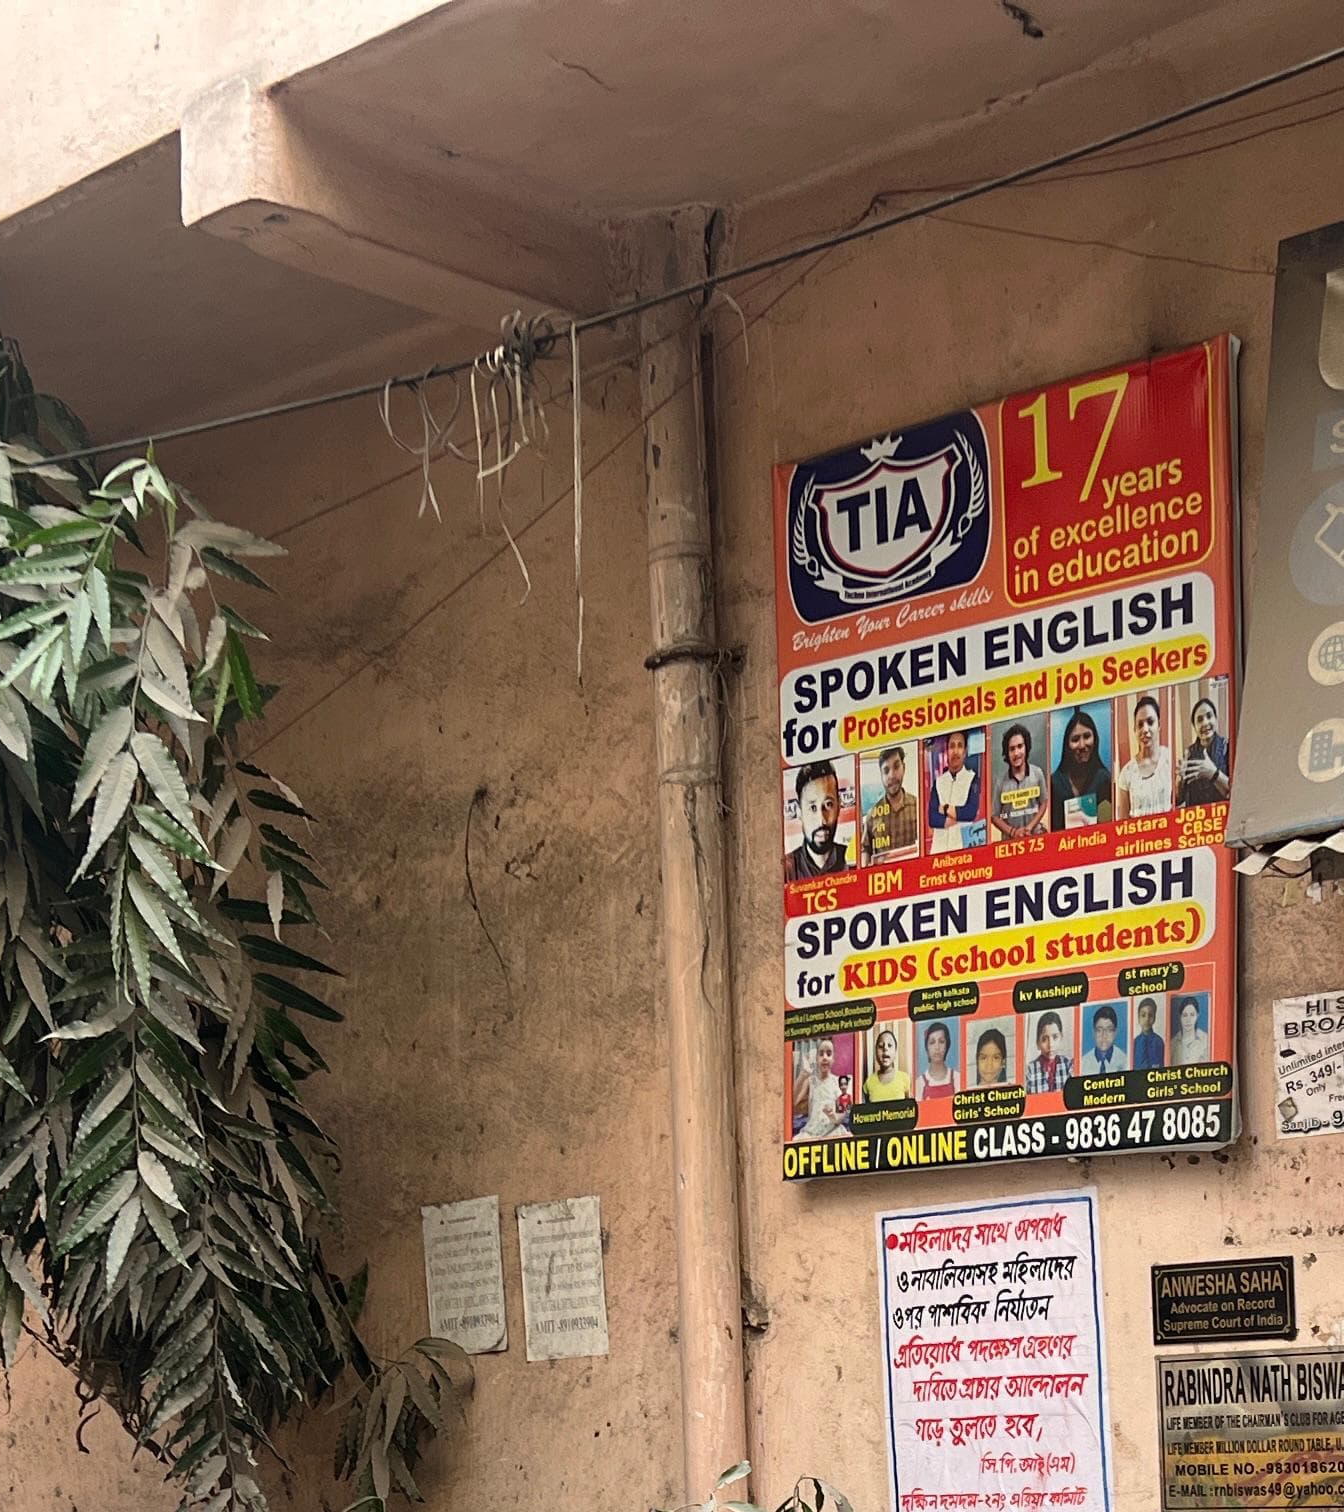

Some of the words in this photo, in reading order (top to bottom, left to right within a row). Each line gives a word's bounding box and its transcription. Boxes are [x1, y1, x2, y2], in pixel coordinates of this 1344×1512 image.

[1017, 372, 1129, 502] 17
[1102, 457, 1183, 509] years
[837, 477, 932, 554] TIA
[1013, 527, 1040, 560] of
[1050, 492, 1203, 547] excellence
[1014, 566, 1040, 596] in
[1048, 528, 1199, 586] education
[792, 625, 850, 652] Brighten
[856, 614, 891, 640] Your
[896, 602, 944, 628] Career
[949, 586, 993, 612] skills
[794, 635, 967, 714] SPOKEN
[985, 583, 1193, 671] ENGLISH
[783, 717, 837, 758] for
[843, 685, 995, 744] Professionals
[1005, 672, 1047, 707] and
[1055, 658, 1093, 705] job
[1102, 639, 1208, 684] Seekers
[995, 841, 1025, 859] IELTS
[1029, 838, 1045, 853] 7.5
[1059, 837, 1075, 852] Air
[1078, 832, 1106, 849] India
[868, 869, 902, 896] IBM
[920, 875, 947, 888] Ernst
[948, 871, 956, 882] &
[958, 867, 992, 883] young
[797, 894, 967, 959] SPOKEN
[985, 856, 1193, 930] ENGLISH
[797, 972, 834, 998] for
[843, 954, 917, 992] KIDS
[927, 937, 1035, 981] (school
[1046, 908, 1202, 962] students)
[1306, 999, 1330, 1015] HI
[1084, 1076, 1124, 1091] Central
[1084, 1093, 1125, 1106] Modern
[784, 1139, 869, 1178] OFFLINE
[887, 1130, 968, 1165] ONLINE
[974, 1122, 1045, 1160] CLASS
[1066, 1113, 1120, 1150] 9836
[1127, 1110, 1155, 1143] 47
[1163, 1104, 1220, 1141] 8085
[899, 1222, 974, 1254] মহিলাদের
[974, 1221, 1012, 1246] সাথে
[1015, 1212, 1067, 1242] অপরাধ
[1003, 1252, 1077, 1284] মহিলাদের
[1161, 1272, 1237, 1298] ANWESHA
[1240, 1270, 1283, 1294] SAHA
[929, 1294, 990, 1328] পাশবিক
[994, 1288, 1053, 1322] নির্যাতন
[1164, 1317, 1209, 1332] Supreme
[1212, 1315, 1241, 1329] Court
[1244, 1314, 1255, 1328] of
[1257, 1312, 1283, 1327] India
[1170, 1299, 1218, 1315] Advocate
[1221, 1301, 1235, 1311] on
[1238, 1297, 1275, 1311] Record
[913, 1371, 957, 1401] দাবিতে
[959, 1376, 1002, 1400] প্রচার
[1005, 1373, 1088, 1399] আন্দোলন
[1165, 1366, 1245, 1406] RABINDRA
[1250, 1362, 1291, 1403] NATH
[950, 1415, 996, 1446] তুলতে
[1175, 1464, 1228, 1476] MOBILE
